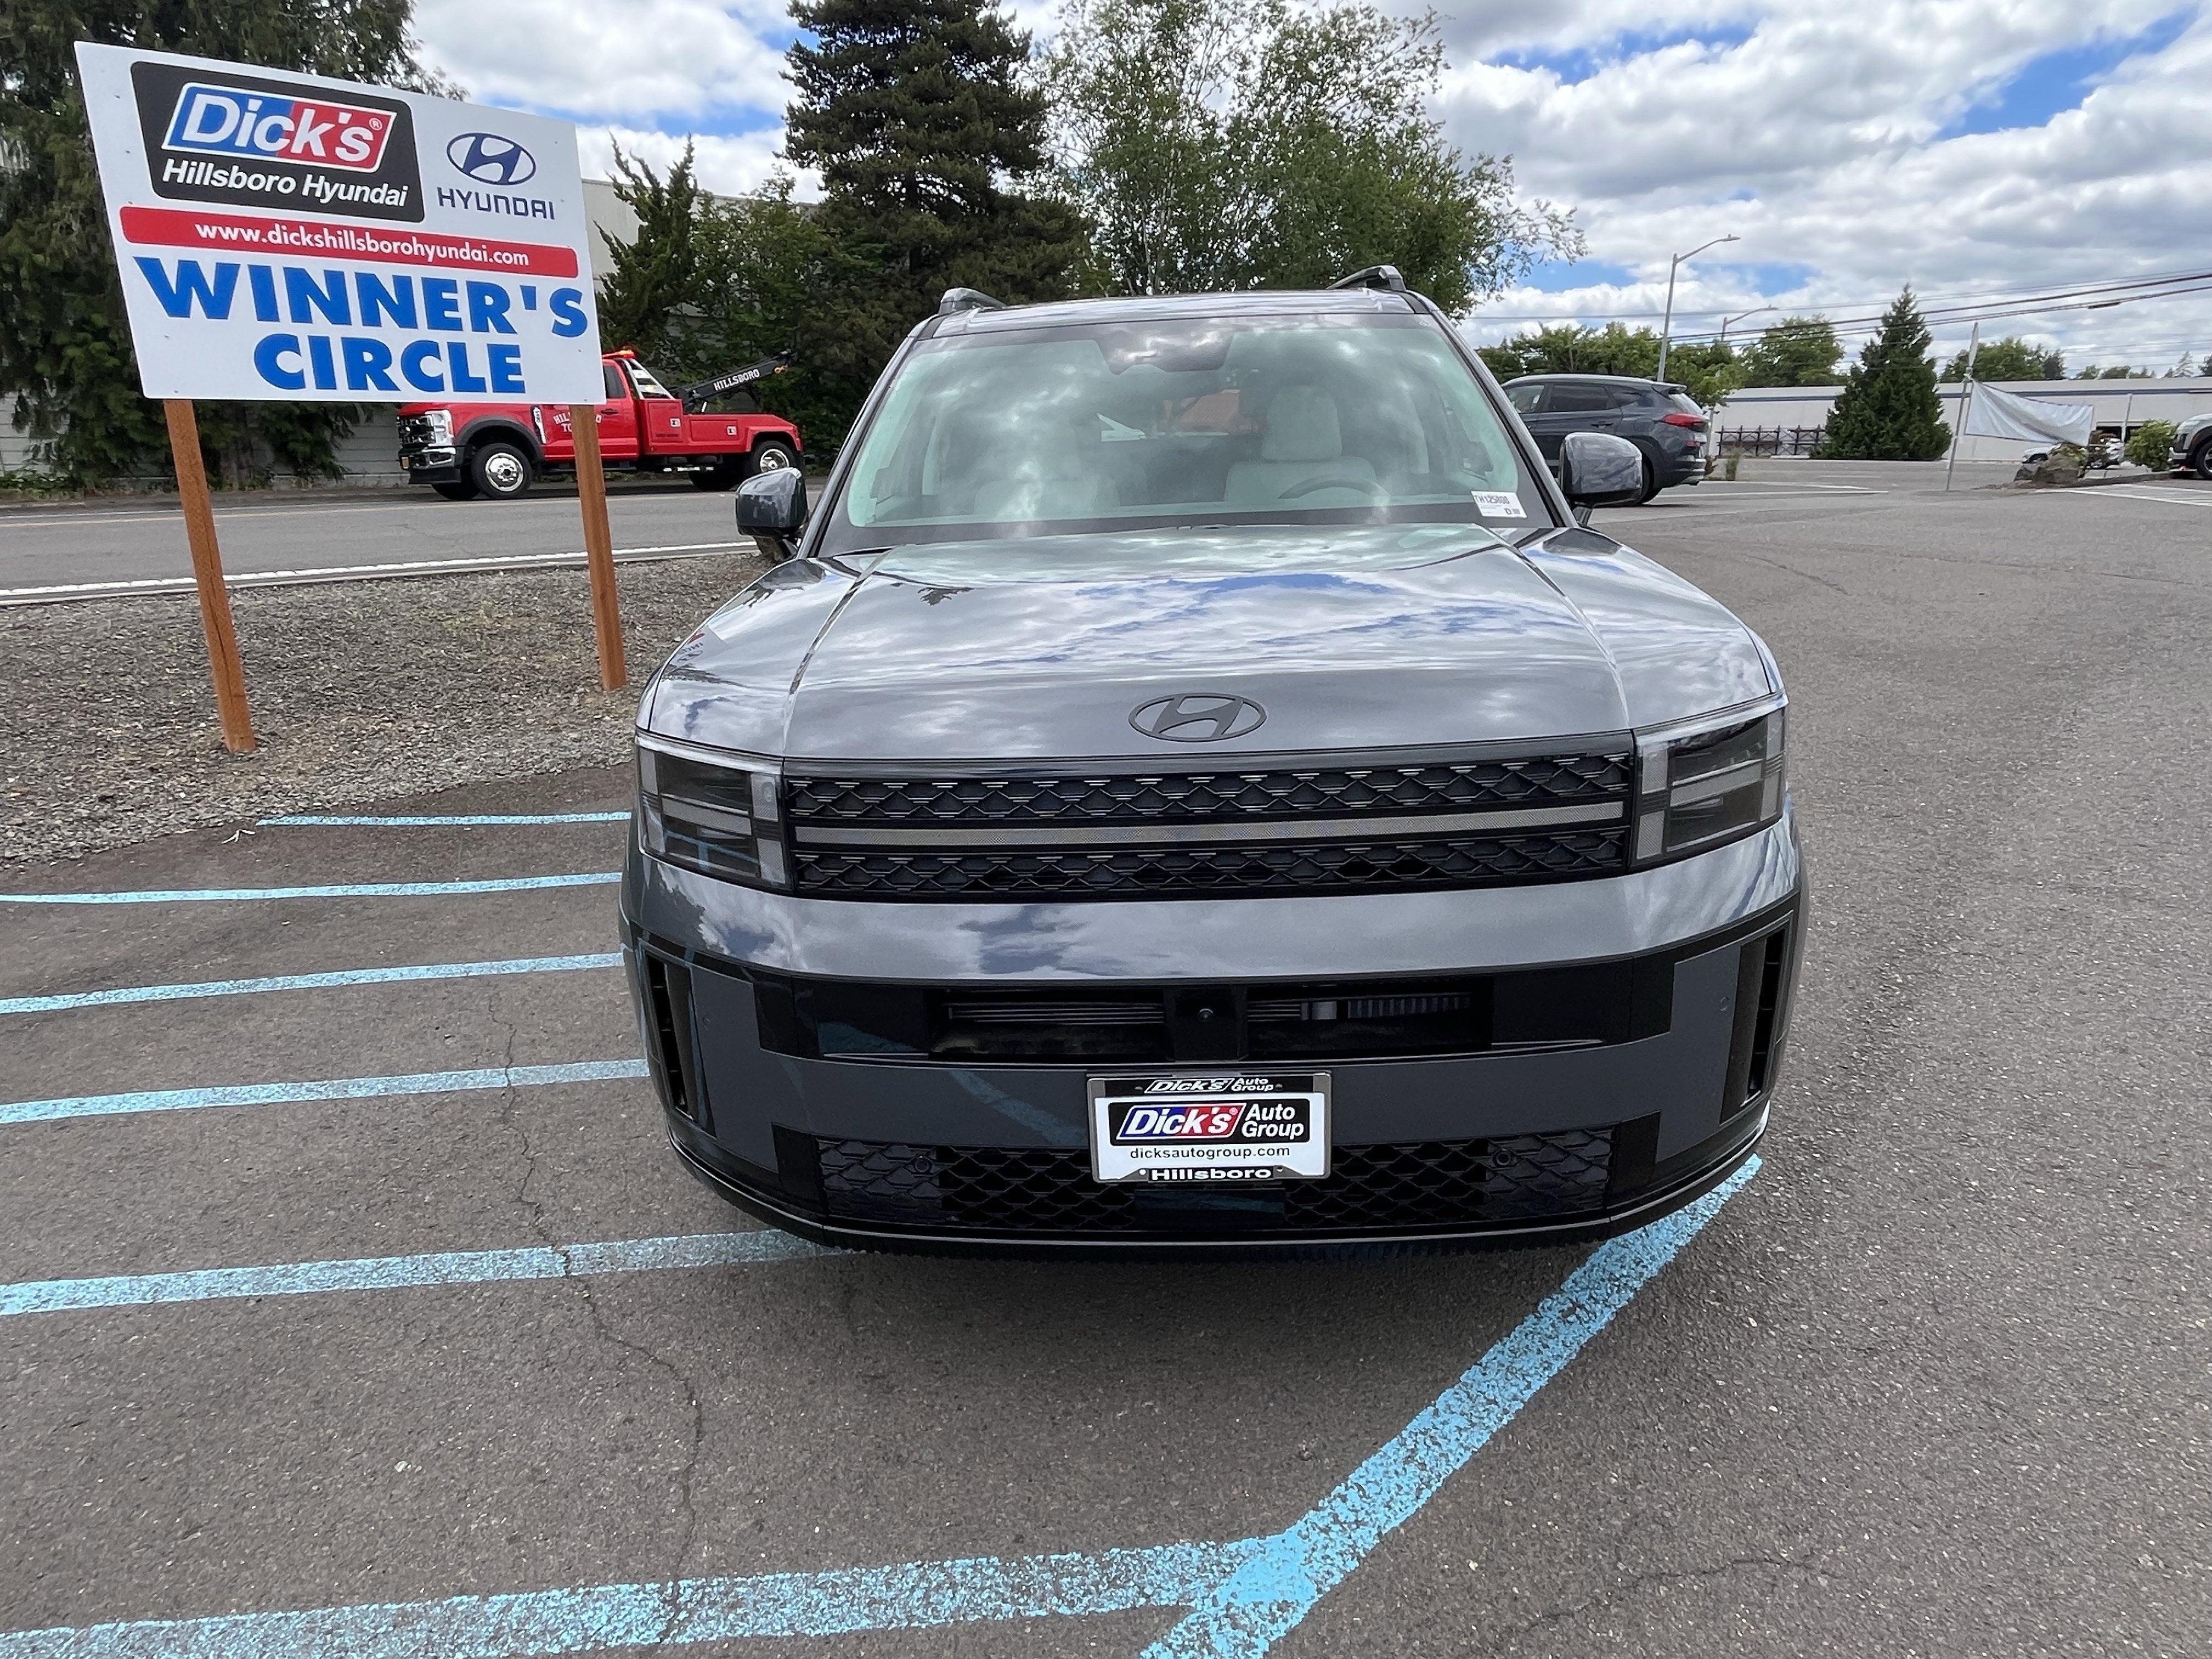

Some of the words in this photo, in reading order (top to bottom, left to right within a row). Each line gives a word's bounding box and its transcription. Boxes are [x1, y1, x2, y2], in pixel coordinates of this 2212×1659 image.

[180, 93, 375, 162] Dick's
[162, 158, 297, 195] Hillsboro
[302, 173, 408, 208] Hyundai
[438, 187, 555, 220] HYUNDAI
[195, 221, 529, 267] www.dickshillsborohyundai.com
[134, 257, 588, 338] WINNER'S
[253, 333, 526, 394] CIRCLE
[713, 369, 760, 391] HILLSBORO
[1231, 1084, 1273, 1092] Group
[1125, 1107, 1231, 1135] Dick's
[1245, 1103, 1296, 1121] Auto
[1241, 1121, 1305, 1139] Group
[1130, 1147, 1290, 1160] dicksautogroup.com
[1152, 1167, 1272, 1181] Hillsboro
